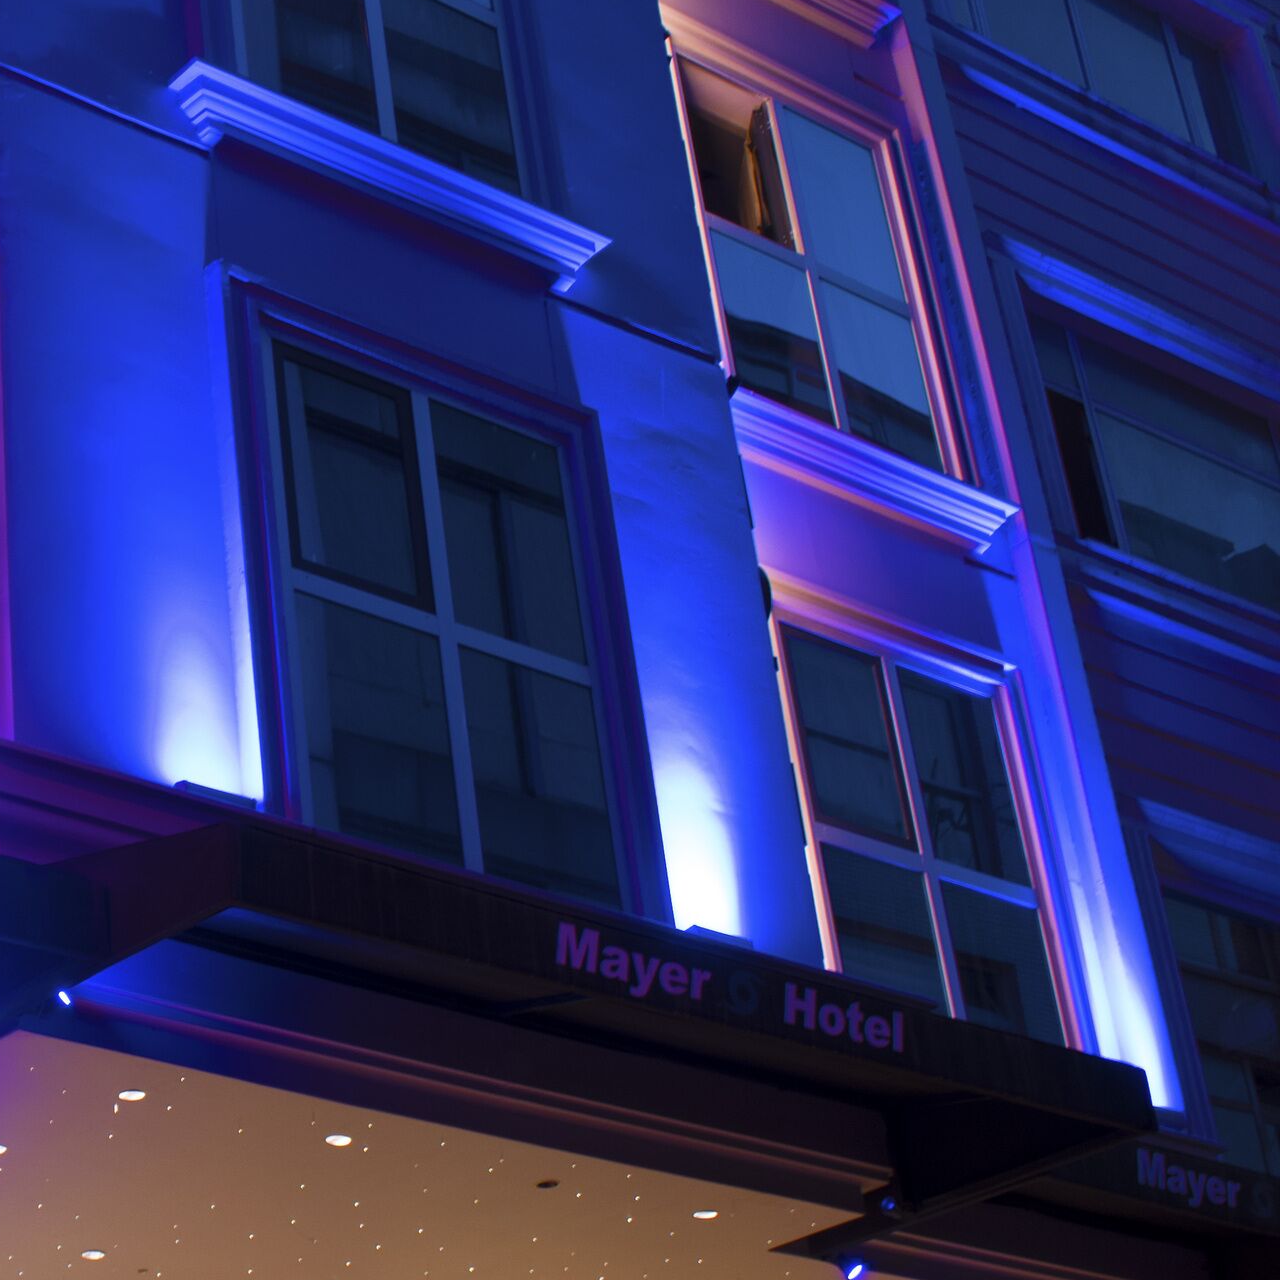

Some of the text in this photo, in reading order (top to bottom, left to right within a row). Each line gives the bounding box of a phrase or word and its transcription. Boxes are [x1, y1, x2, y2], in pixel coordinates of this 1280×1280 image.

[555, 921, 904, 1054] Mayer Hotel
[1137, 1148, 1241, 1209] Mayer
